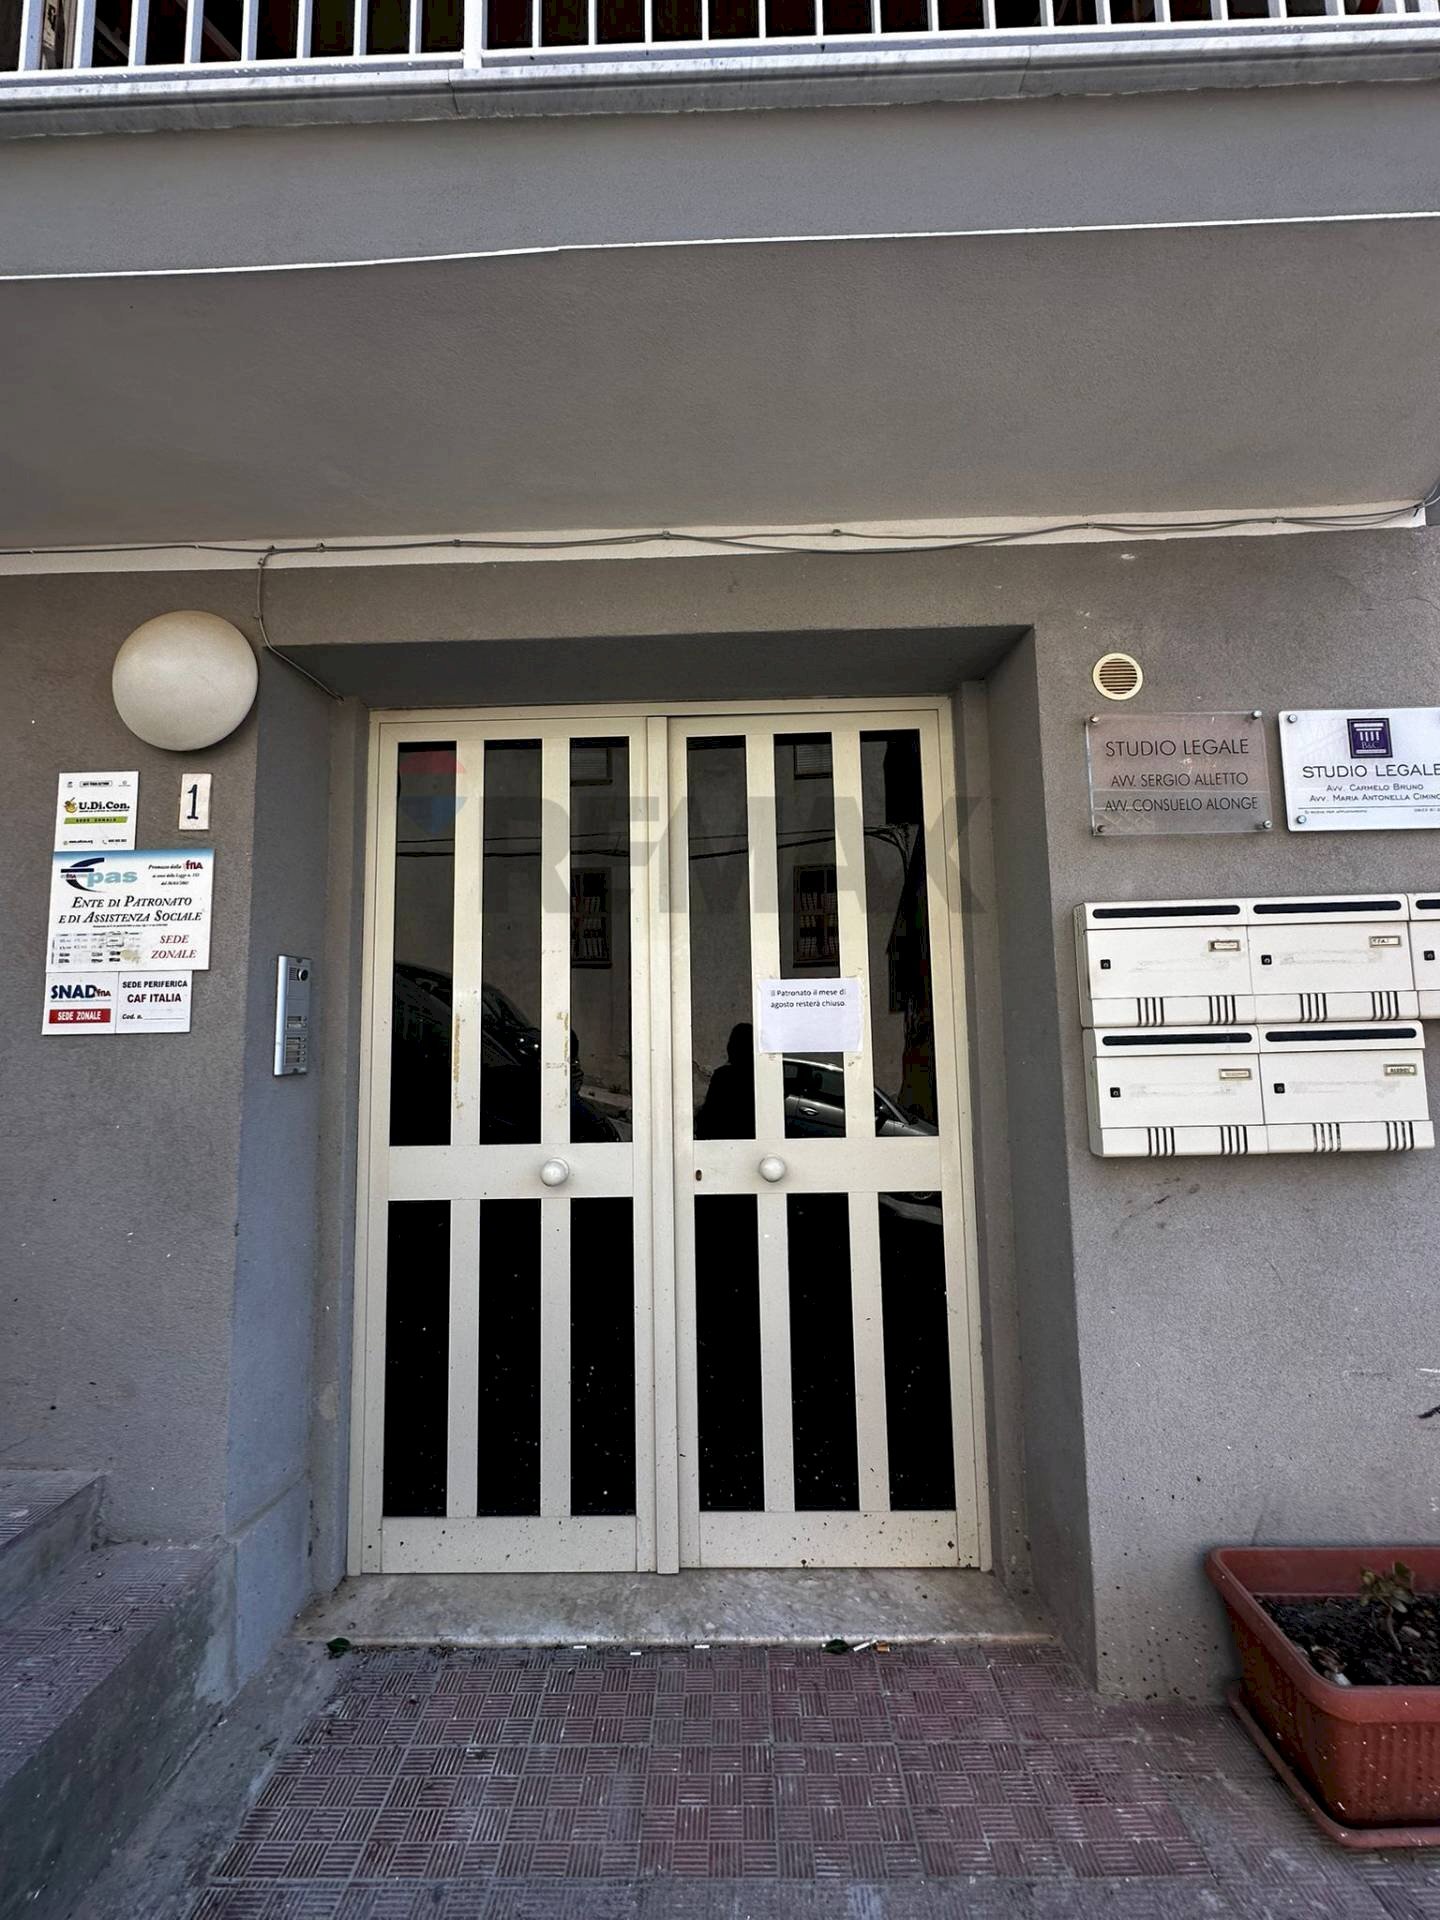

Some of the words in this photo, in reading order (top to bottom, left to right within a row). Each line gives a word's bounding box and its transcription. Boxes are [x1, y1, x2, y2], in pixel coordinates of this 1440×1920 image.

[1105, 739, 1177, 757] STUDIO
[1183, 738, 1249, 756] LEGALE
[1302, 765, 1367, 778] STUDIO
[1375, 763, 1440, 777] LEGALE
[1141, 773, 1190, 787] SERGIO
[1194, 772, 1248, 786] ALLETTO
[79, 801, 130, 810] U.Di.Con.
[187, 784, 199, 820] 1
[1132, 798, 1203, 812] CONSUELO
[1206, 797, 1258, 810] ALONGE
[160, 935, 189, 944] SEDE
[151, 950, 197, 959] ZONALE
[144, 980, 188, 988] PERIFERICA
[51, 984, 97, 999] SNAD
[777, 989, 812, 997] Patronato
[127, 994, 147, 1003] CAF
[150, 993, 182, 1002] ITALIA
[57, 1011, 74, 1020] SEDE
[76, 1010, 101, 1020] ZONALE
